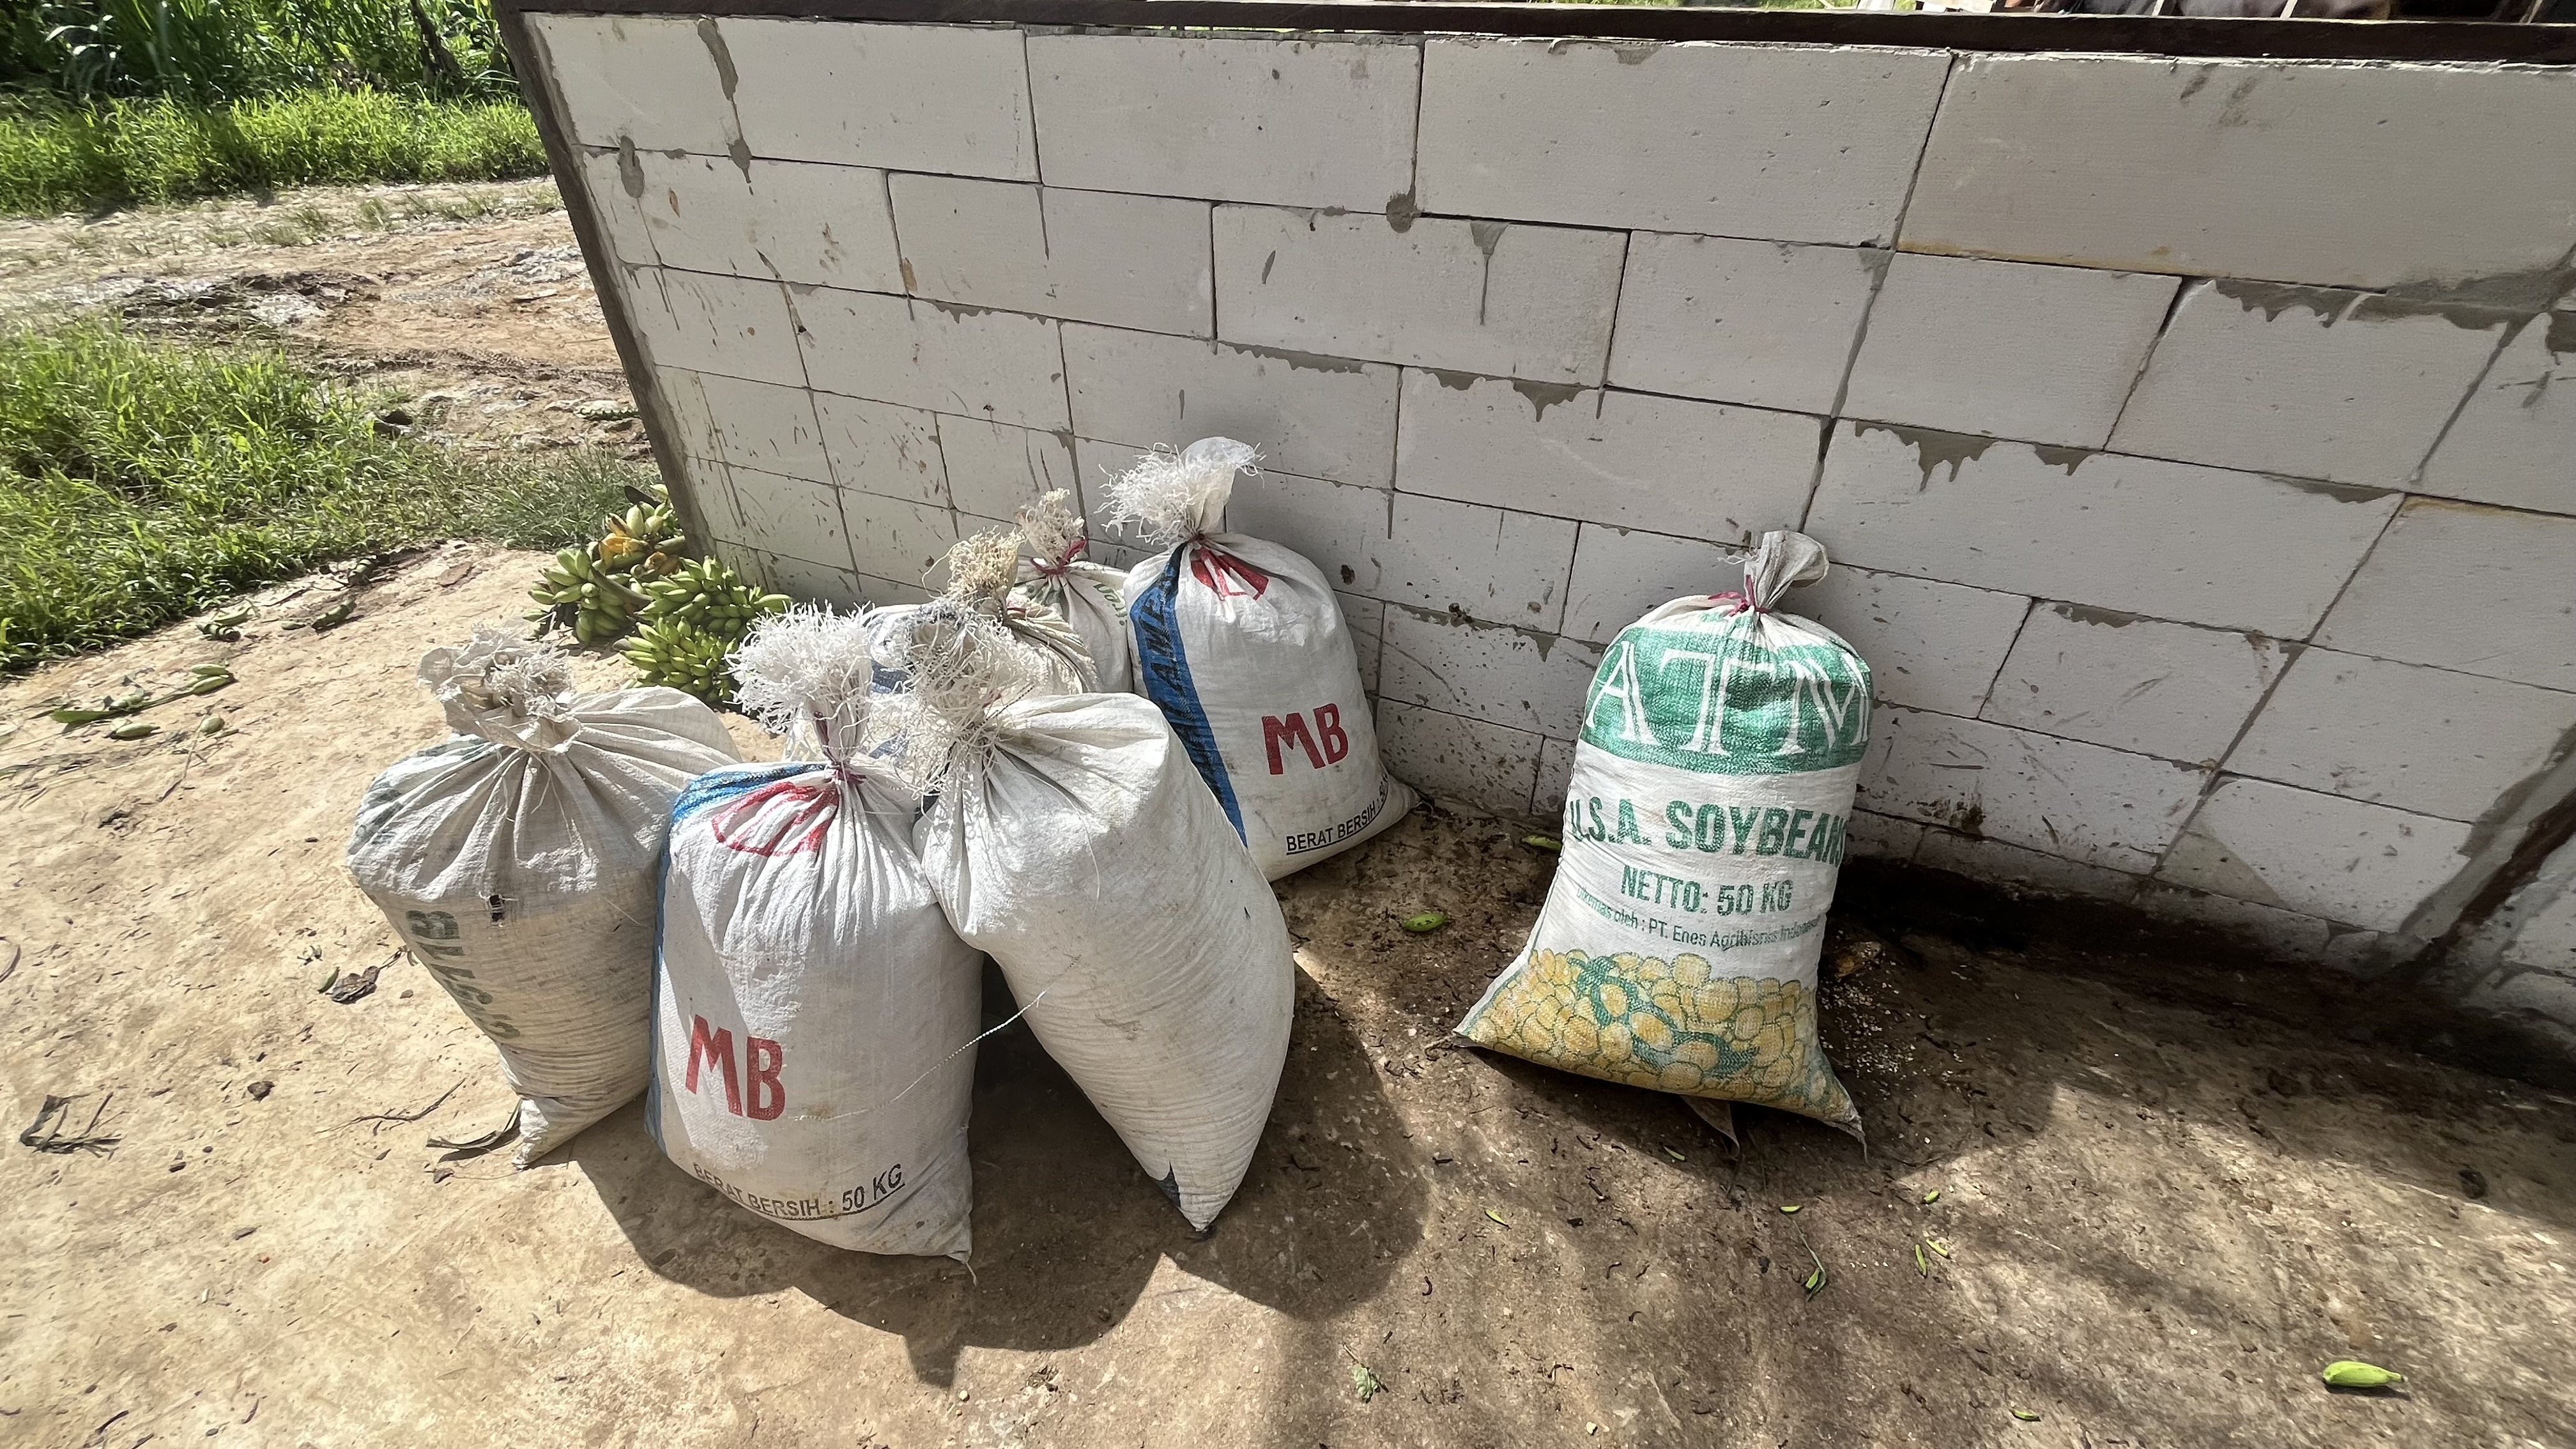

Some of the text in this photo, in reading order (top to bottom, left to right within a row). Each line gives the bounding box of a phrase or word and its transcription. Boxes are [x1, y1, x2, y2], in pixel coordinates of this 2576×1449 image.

[1261, 703, 1349, 775] MB
[1286, 827, 1333, 851] BERAT
[1337, 801, 1376, 839] BERSIH
[1621, 864, 1793, 916] NETTO: 50 KG
[1614, 908, 1638, 929] oleh
[1649, 917, 1668, 939] PT.
[1673, 926, 1706, 947] Enes
[685, 1014, 786, 1122] MB
[693, 1162, 745, 1203] BERAT
[747, 1192, 820, 1216] BERSIH
[843, 1186, 864, 1211] 50
[873, 1163, 903, 1201] KG
